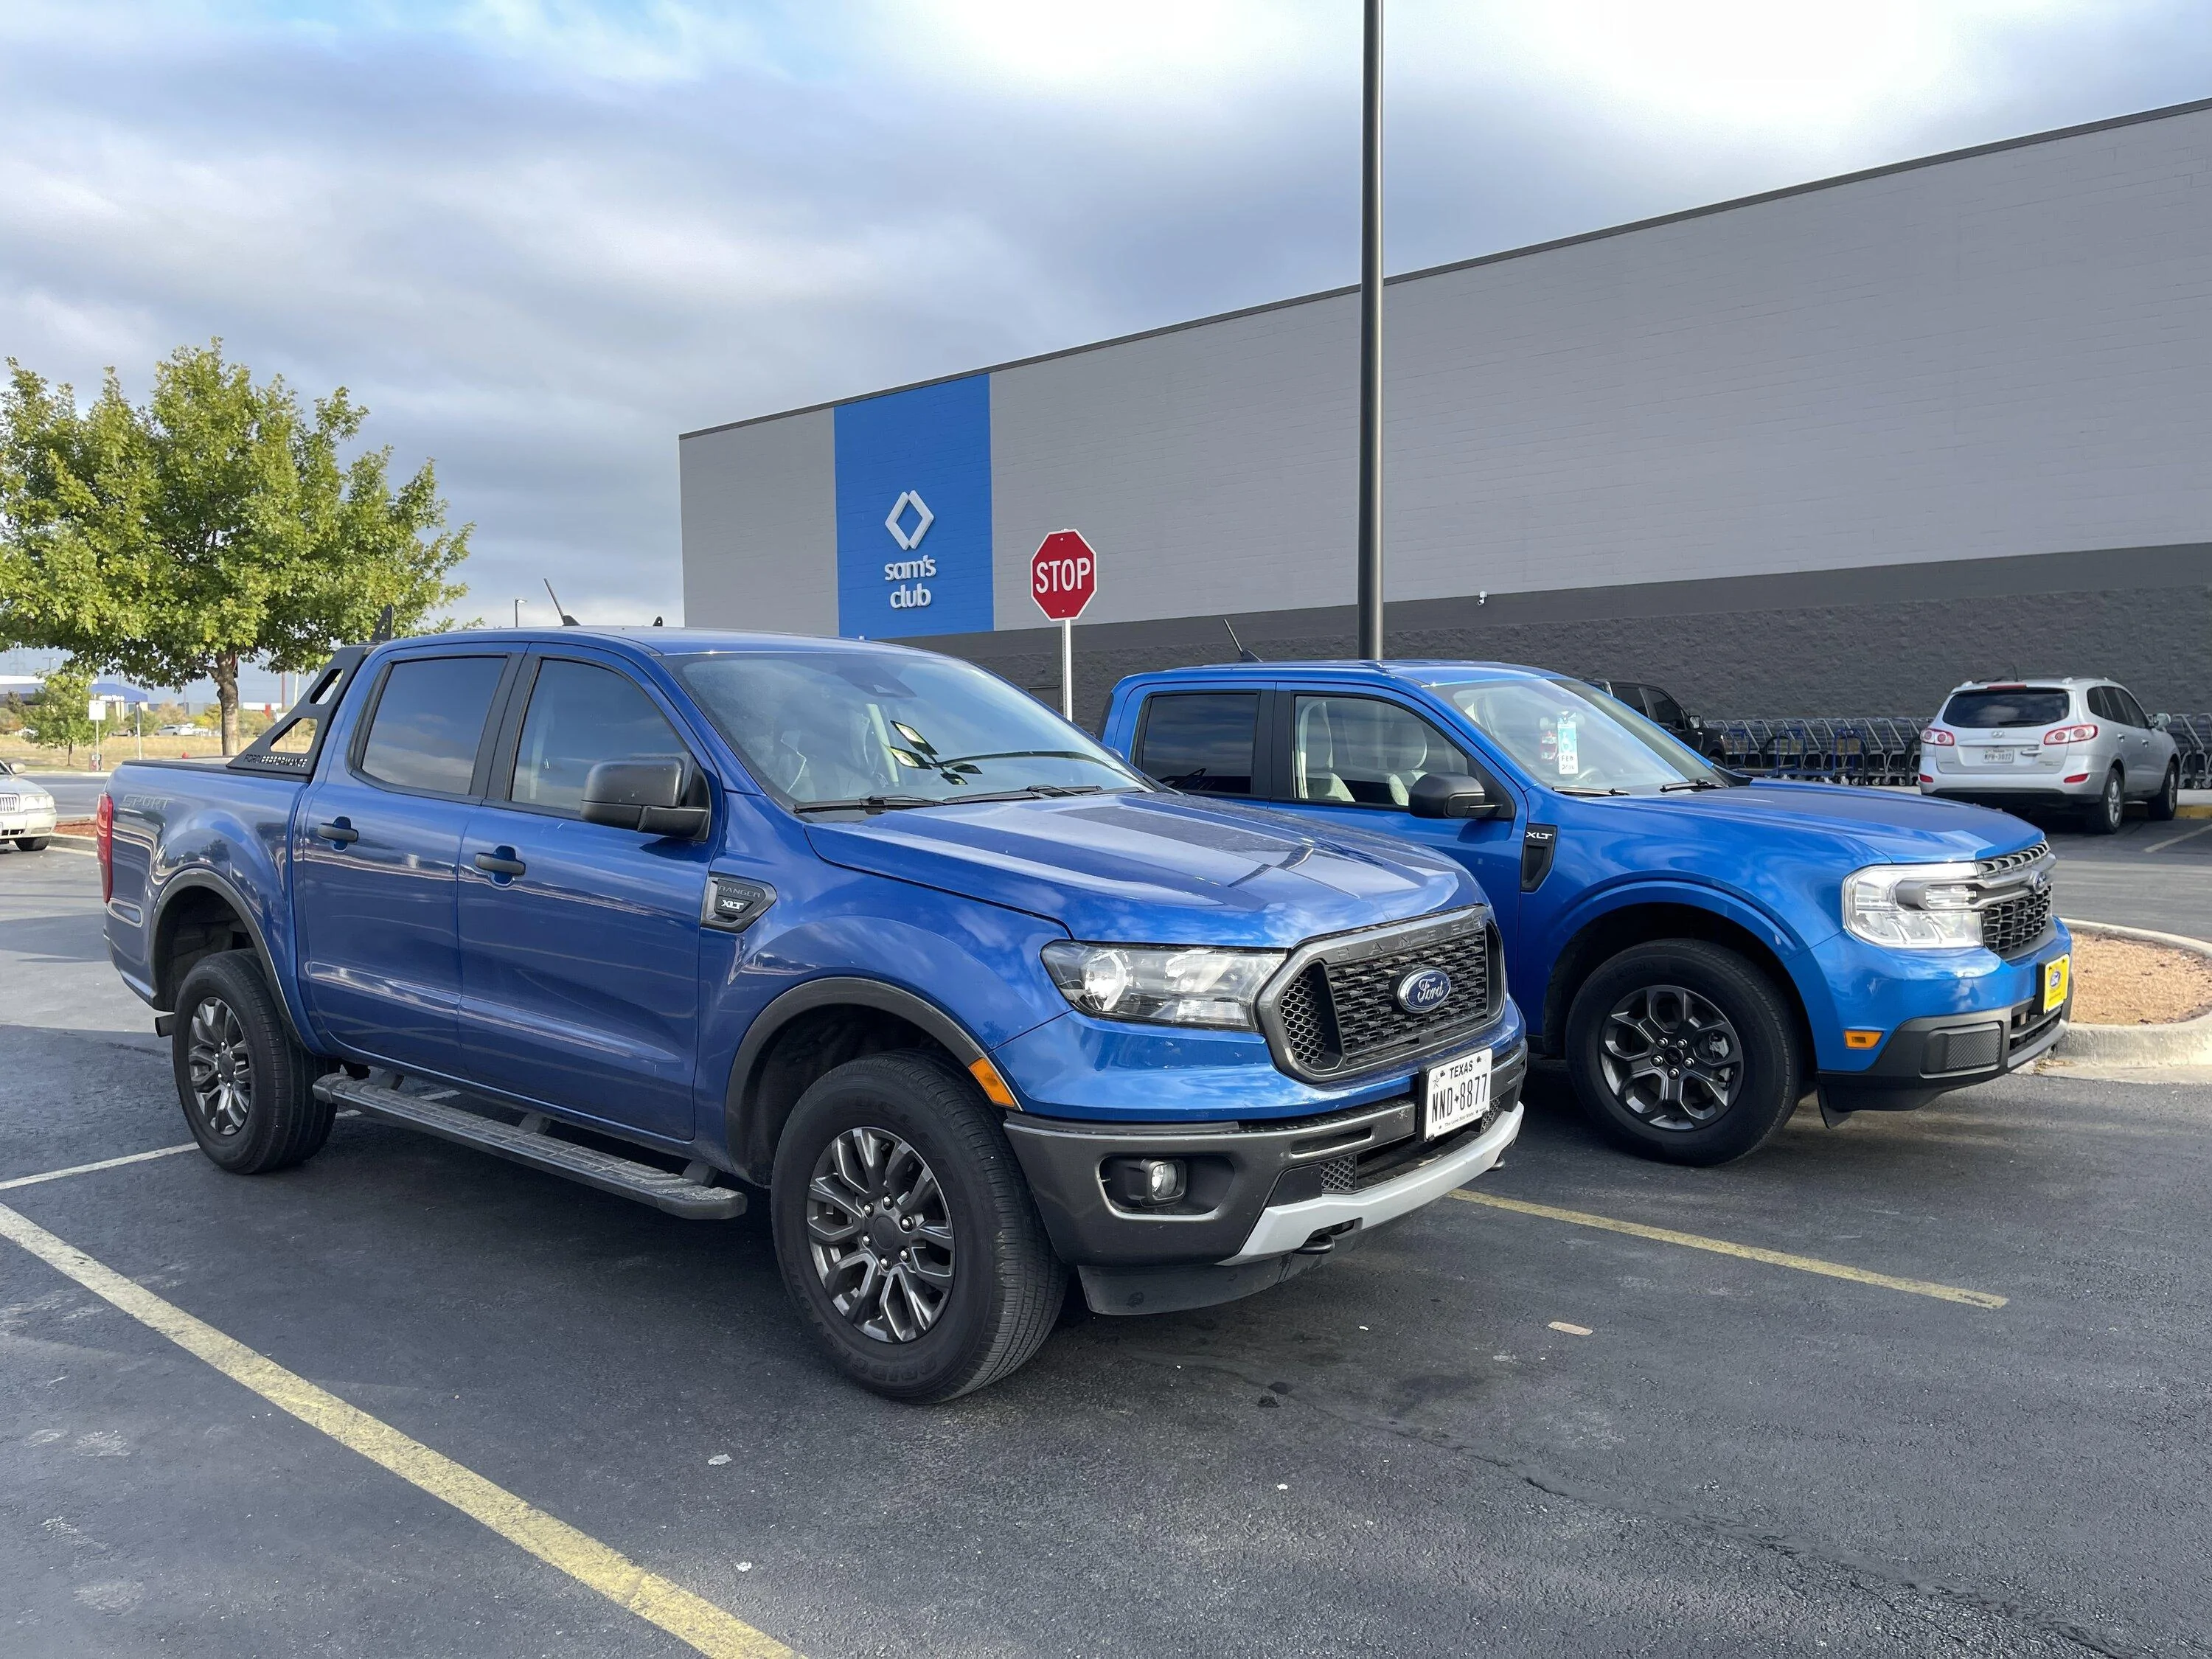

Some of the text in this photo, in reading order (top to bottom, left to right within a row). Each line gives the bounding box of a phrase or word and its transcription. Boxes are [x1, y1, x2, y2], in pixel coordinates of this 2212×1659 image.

[885, 555, 936, 581] sam's
[1035, 557, 1091, 594] STOP
[890, 583, 931, 609] club
[119, 795, 175, 810] SPORT
[718, 886, 761, 898] RANGER
[721, 900, 744, 909] XLT
[1417, 977, 1444, 1003] Ford
[1450, 1060, 1473, 1079] TEXAS
